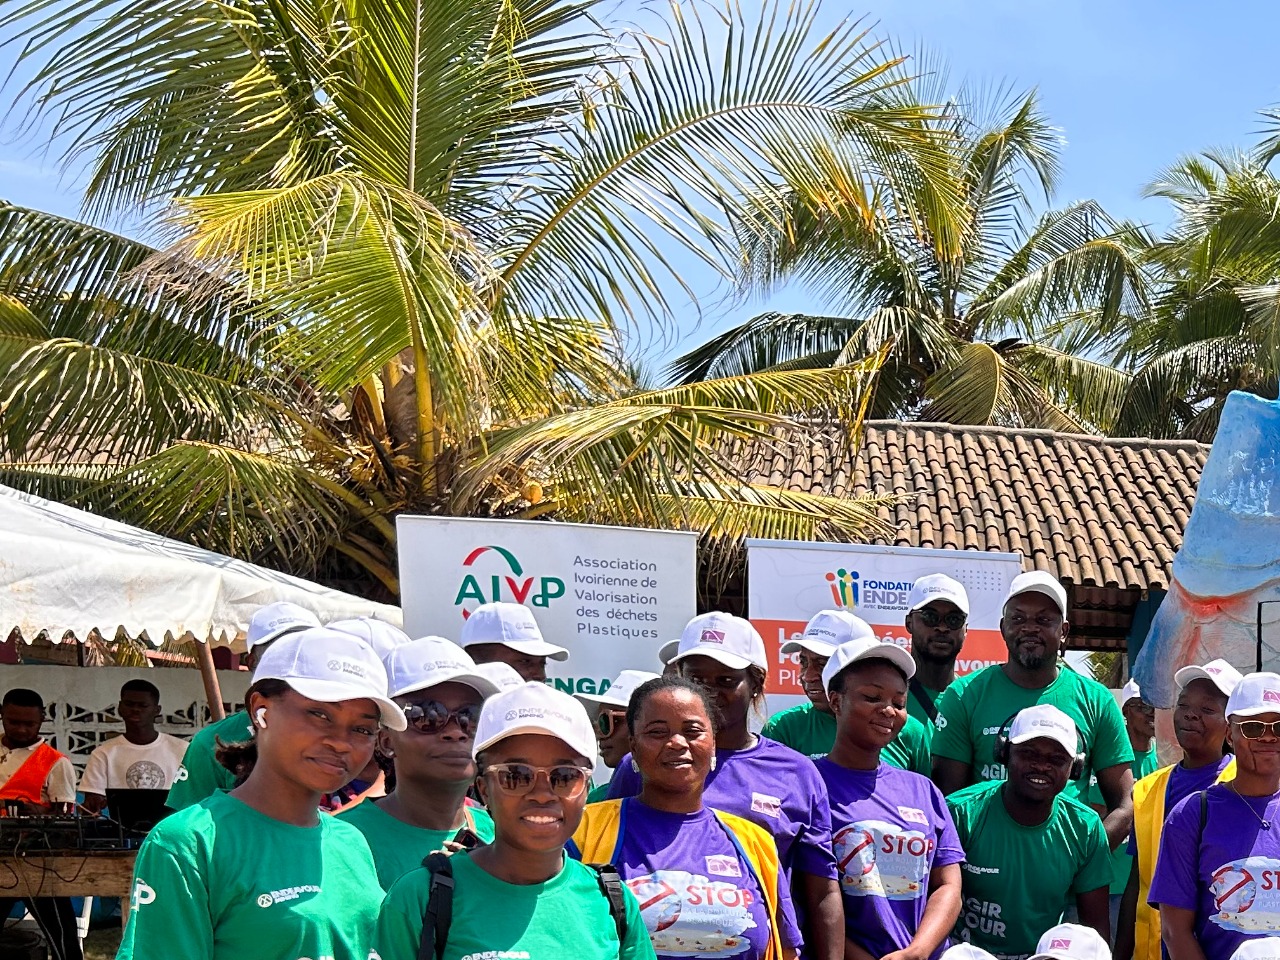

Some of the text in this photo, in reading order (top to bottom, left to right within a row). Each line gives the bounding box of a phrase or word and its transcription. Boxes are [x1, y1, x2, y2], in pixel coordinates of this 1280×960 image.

[573, 555, 657, 572] Association
[574, 573, 657, 589] Ivoirienne de
[863, 580, 915, 591] FONDATI
[575, 589, 657, 605] Valorisation
[863, 590, 908, 605] ENDE
[576, 605, 658, 622] des déchets
[577, 622, 658, 639] Plastiques
[779, 627, 803, 643] Le
[779, 648, 801, 664] Fo
[882, 834, 933, 861] STOP
[686, 885, 754, 908] STOP
[963, 896, 1002, 919] GIR
[960, 912, 1006, 938] OUR
